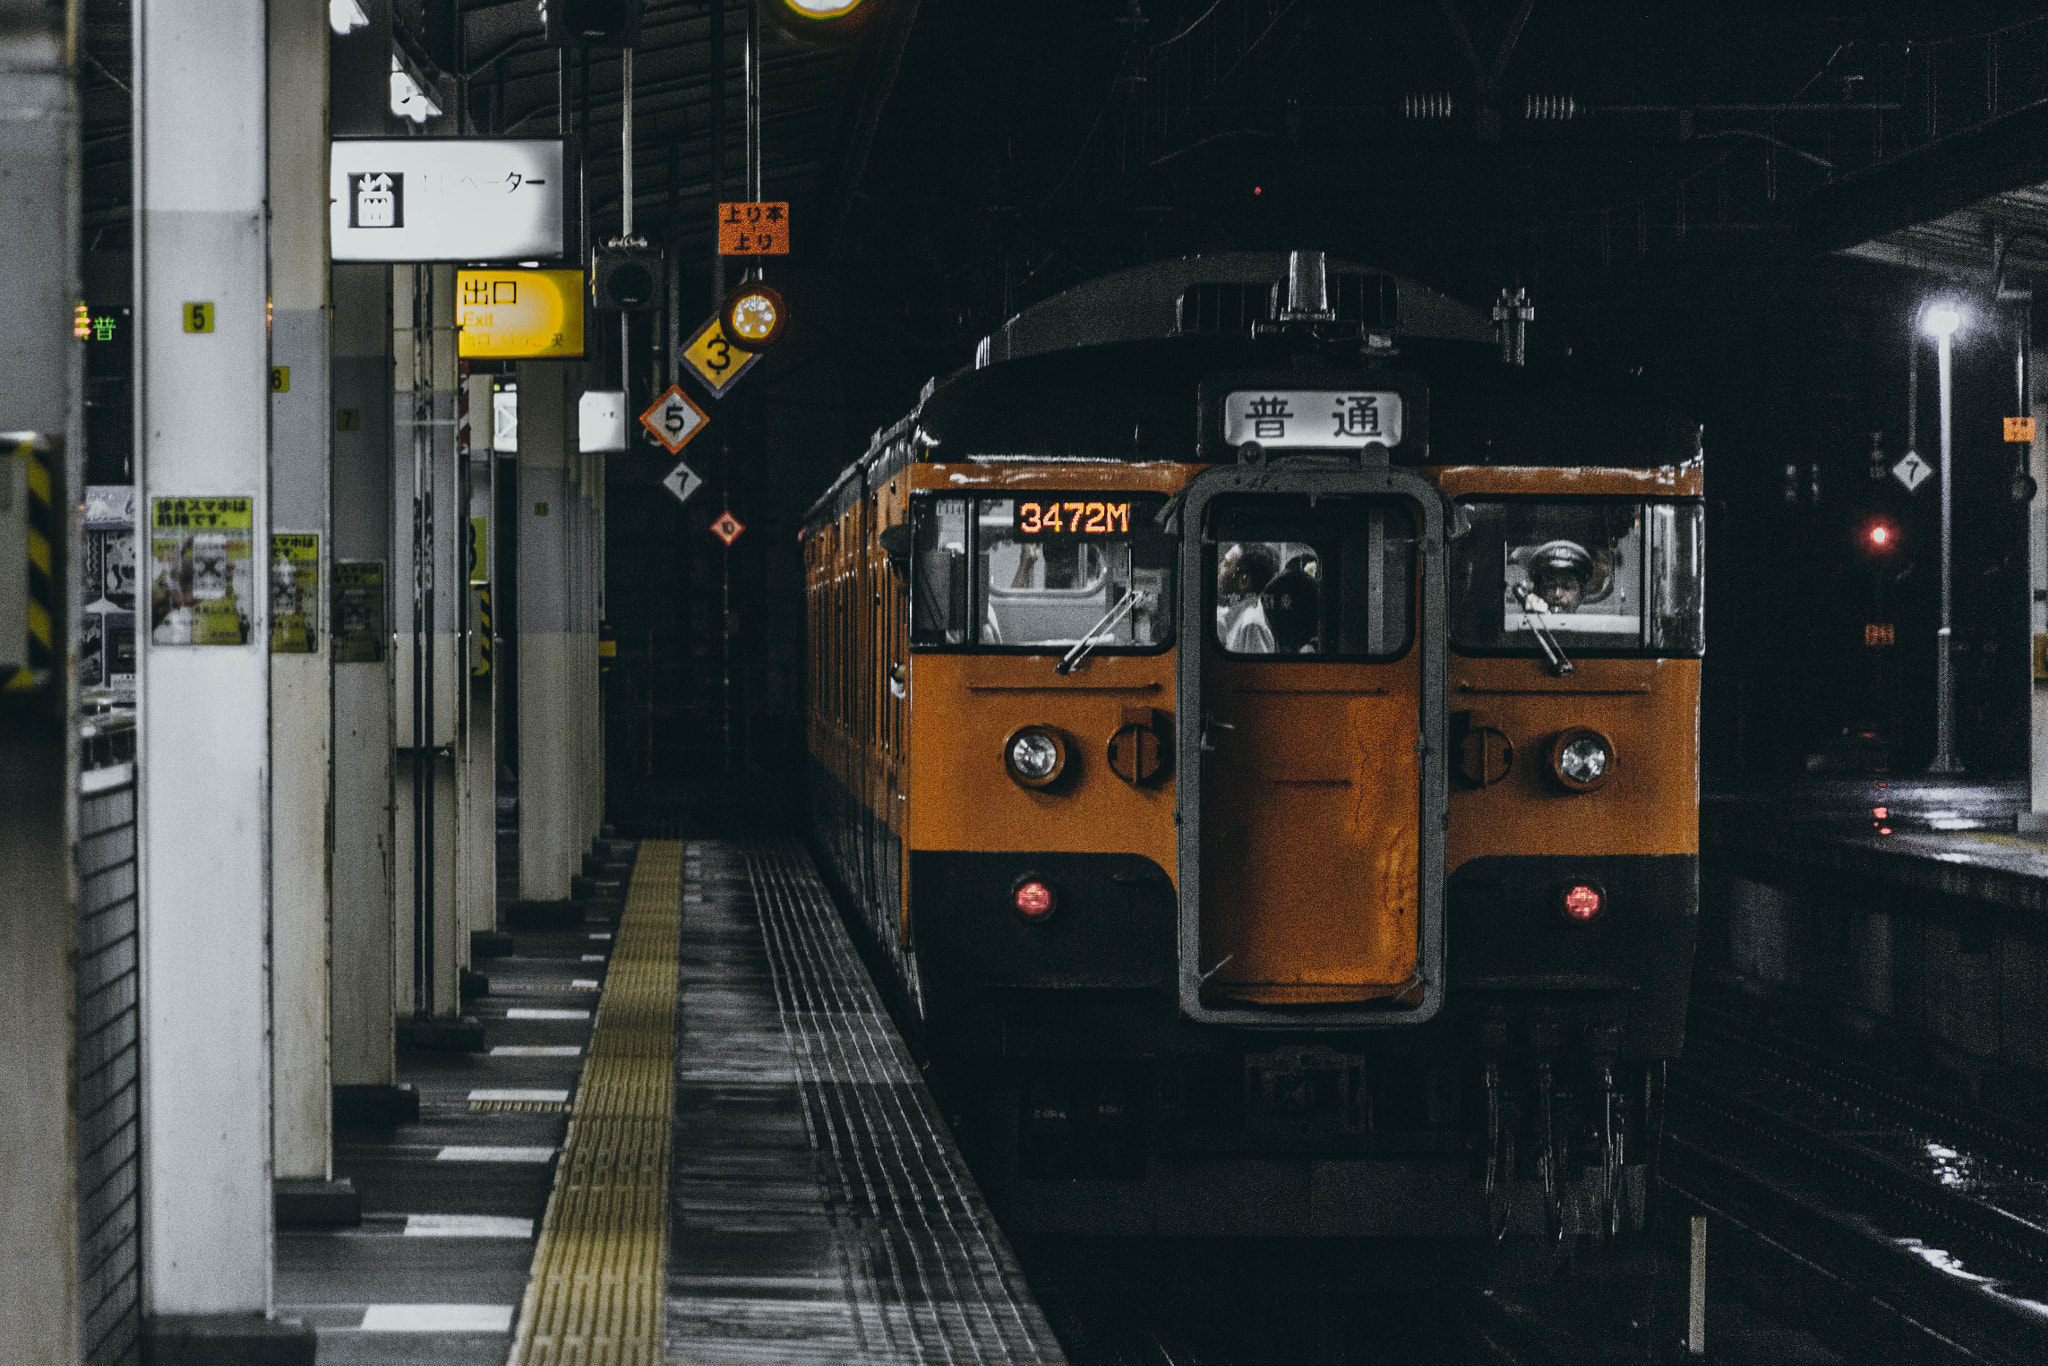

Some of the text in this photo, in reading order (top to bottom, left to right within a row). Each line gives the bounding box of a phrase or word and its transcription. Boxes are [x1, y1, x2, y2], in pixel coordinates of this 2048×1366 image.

[724, 205, 784, 223] 上り本
[734, 233, 772, 251] 上り
[464, 279, 517, 305] 出口
[93, 316, 116, 341] 普
[193, 305, 205, 330] 5
[463, 312, 494, 327] Exit
[706, 338, 731, 371] 3
[271, 370, 282, 389] 6
[344, 411, 352, 428] 7
[665, 405, 684, 432] 5
[1245, 395, 1382, 439] 普通
[676, 470, 690, 495] 7
[1906, 460, 1920, 482] 7
[1020, 502, 1128, 533] 3472M
